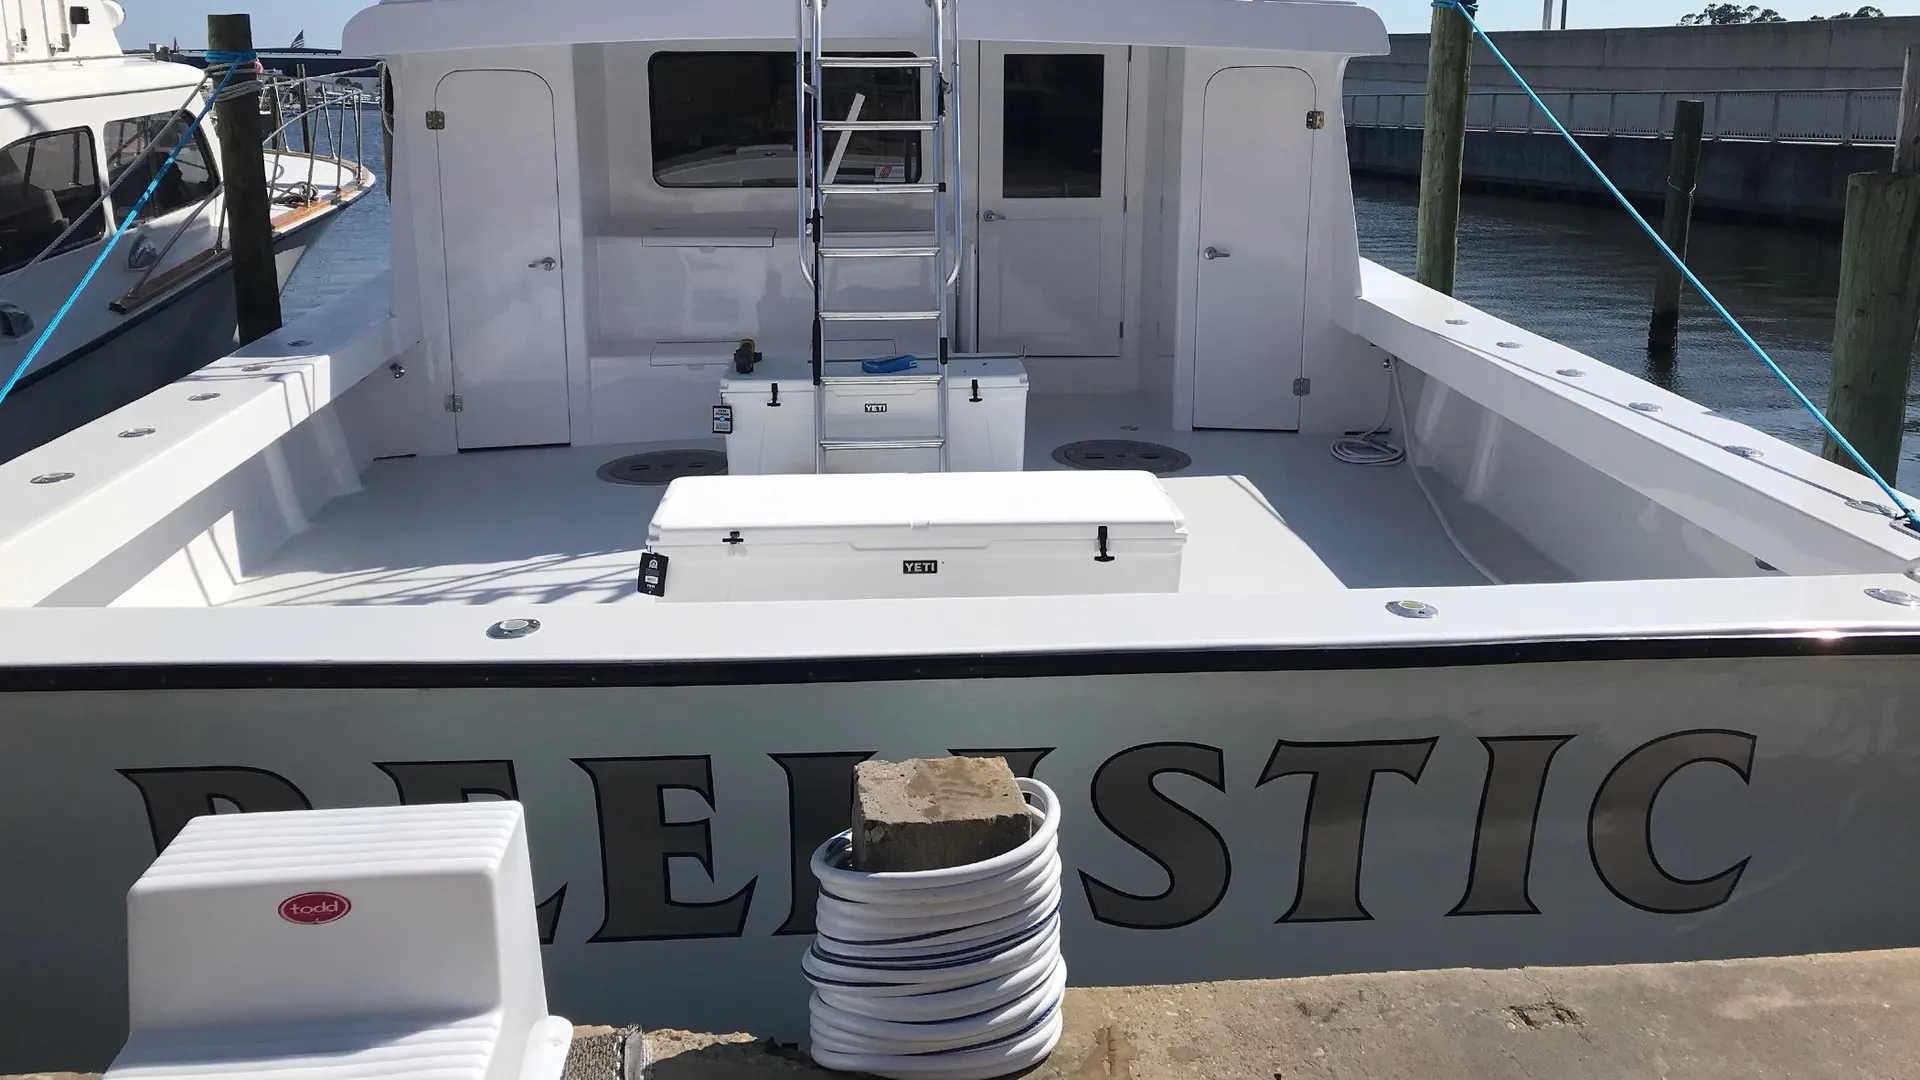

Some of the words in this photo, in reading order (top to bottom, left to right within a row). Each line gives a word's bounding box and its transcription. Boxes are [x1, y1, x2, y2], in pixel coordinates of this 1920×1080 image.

[865, 404, 886, 412] YETI
[904, 562, 935, 572] YETI
[115, 729, 1757, 945] ESTIC
[290, 901, 338, 915] todd
